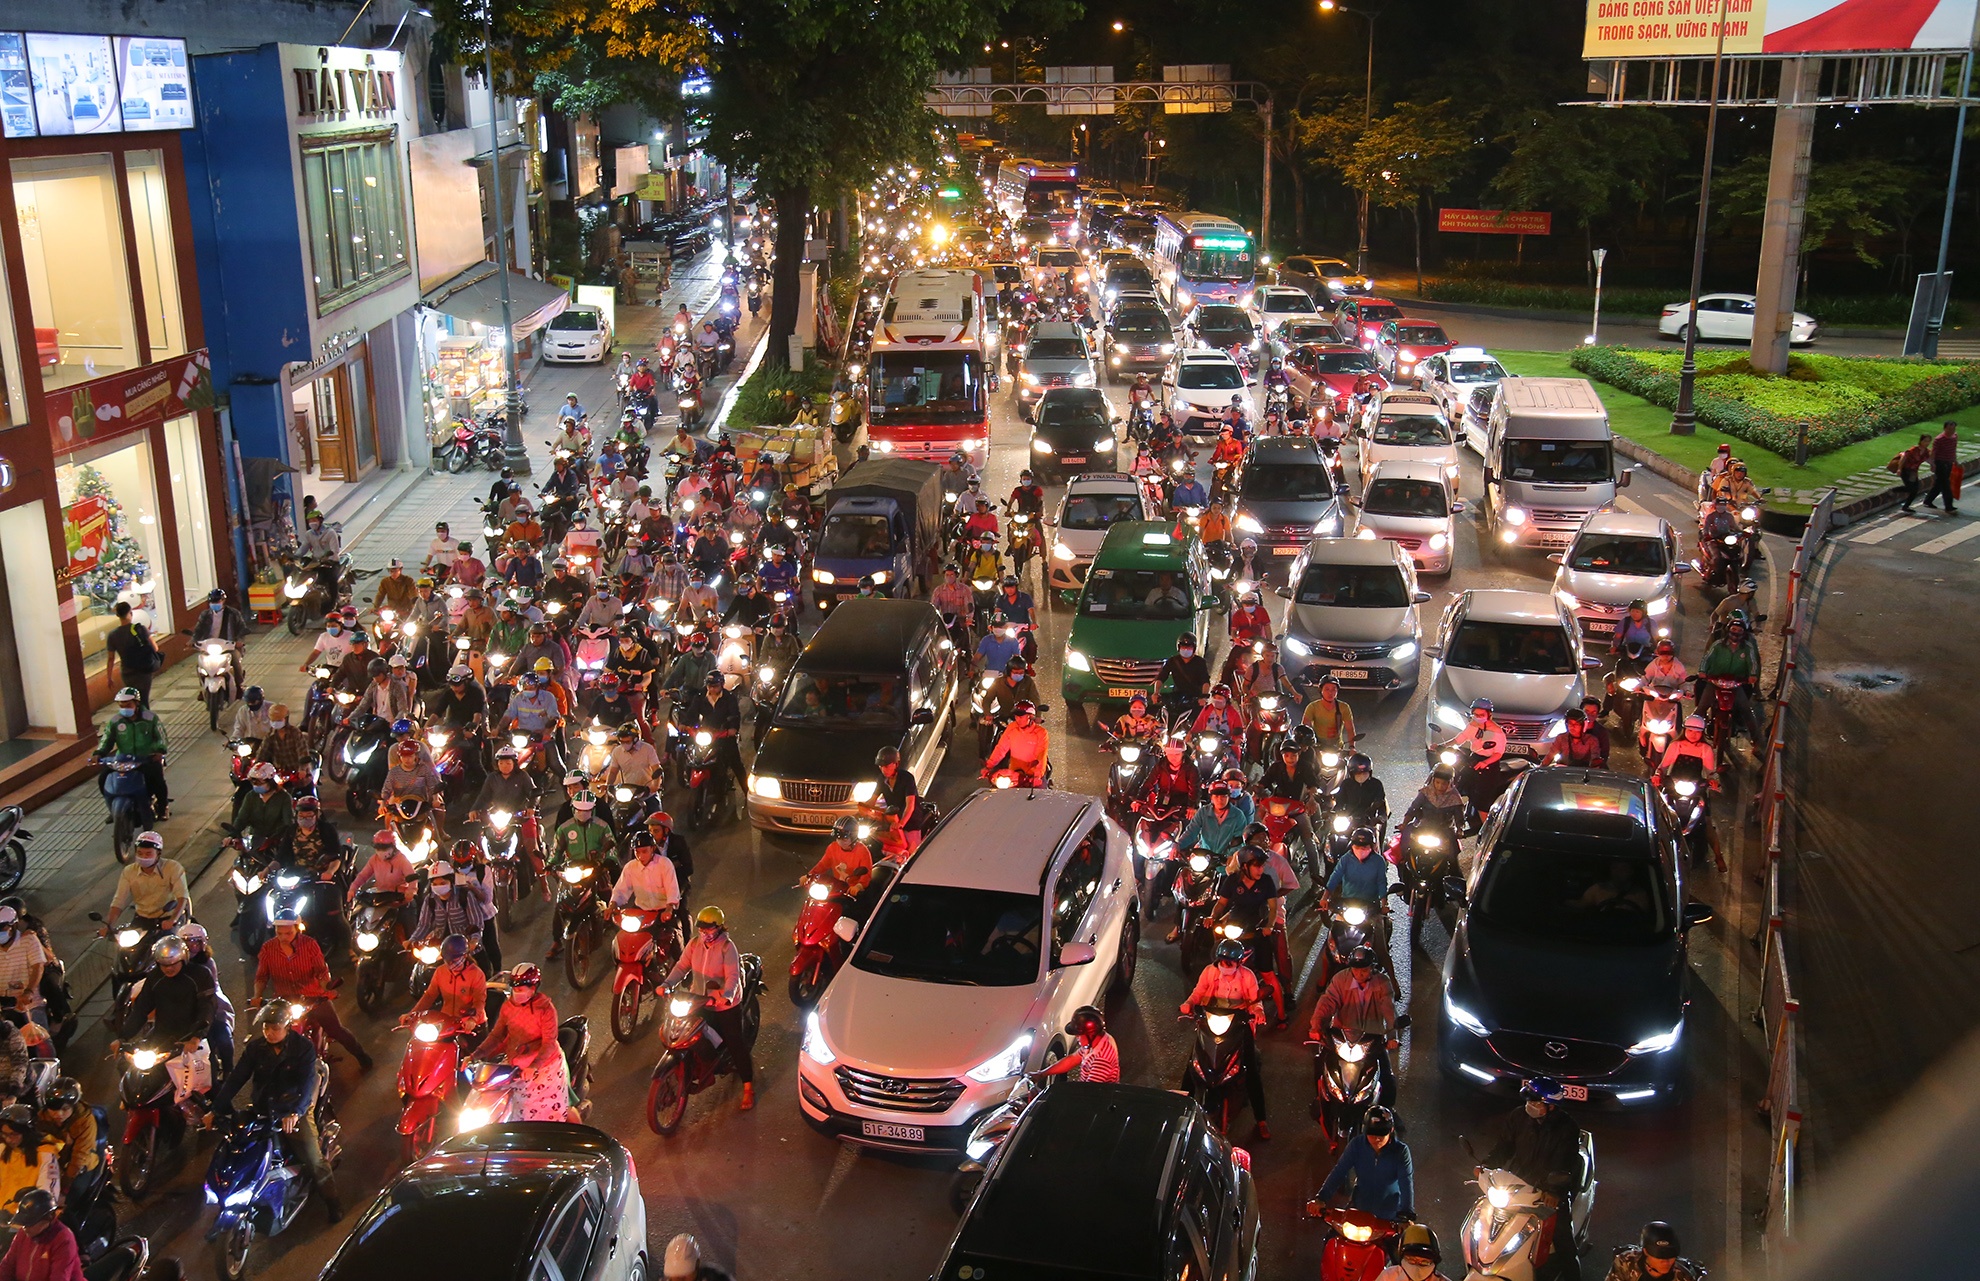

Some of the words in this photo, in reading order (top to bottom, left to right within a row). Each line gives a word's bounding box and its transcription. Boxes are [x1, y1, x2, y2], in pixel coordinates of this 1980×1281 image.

[1598, 25, 1634, 41] TRONG
[1676, 20, 1707, 38] VỮNG
[293, 48, 350, 117] HẢI
[349, 54, 396, 113] VÂN
[1240, 253, 1248, 261] 8
[864, 1123, 923, 1140] 51F-348.89
